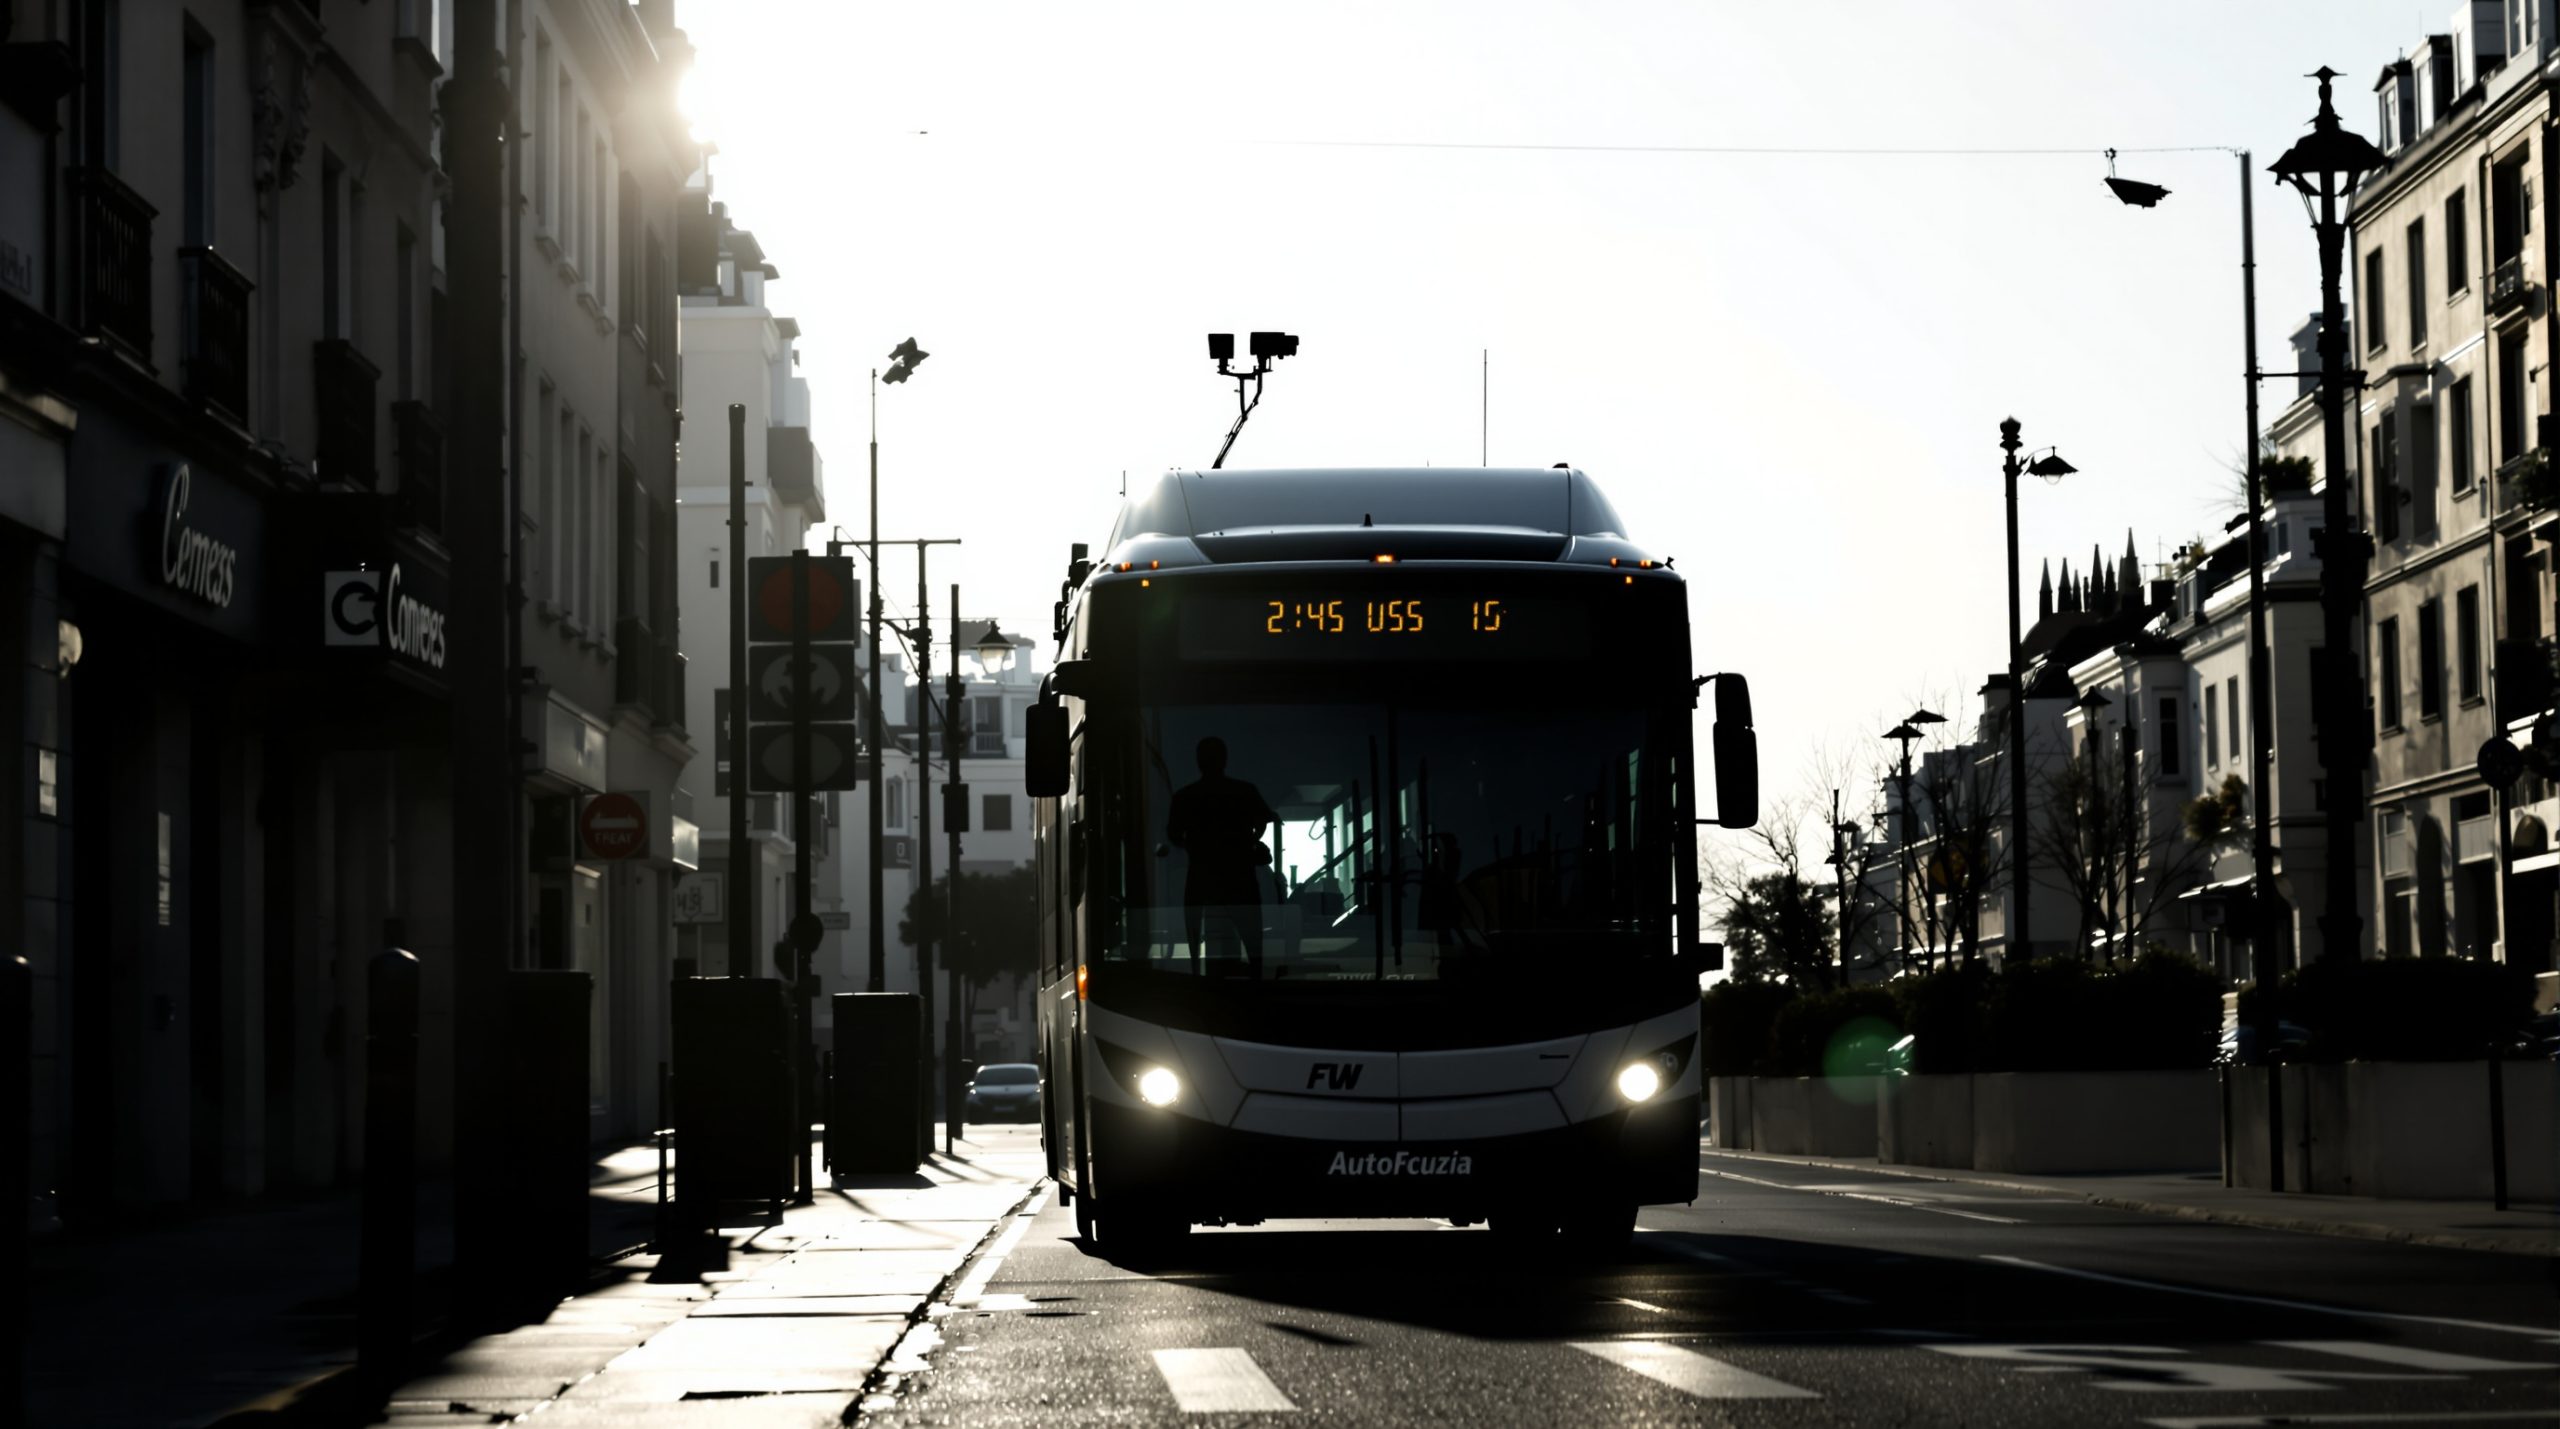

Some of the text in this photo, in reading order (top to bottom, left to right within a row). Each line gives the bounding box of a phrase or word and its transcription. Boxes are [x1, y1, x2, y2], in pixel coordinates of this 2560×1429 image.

[1267, 601, 1343, 632] 2:45
[1307, 1063, 1363, 1090] FW
[1327, 1149, 1472, 1176] AutoFcuzia
